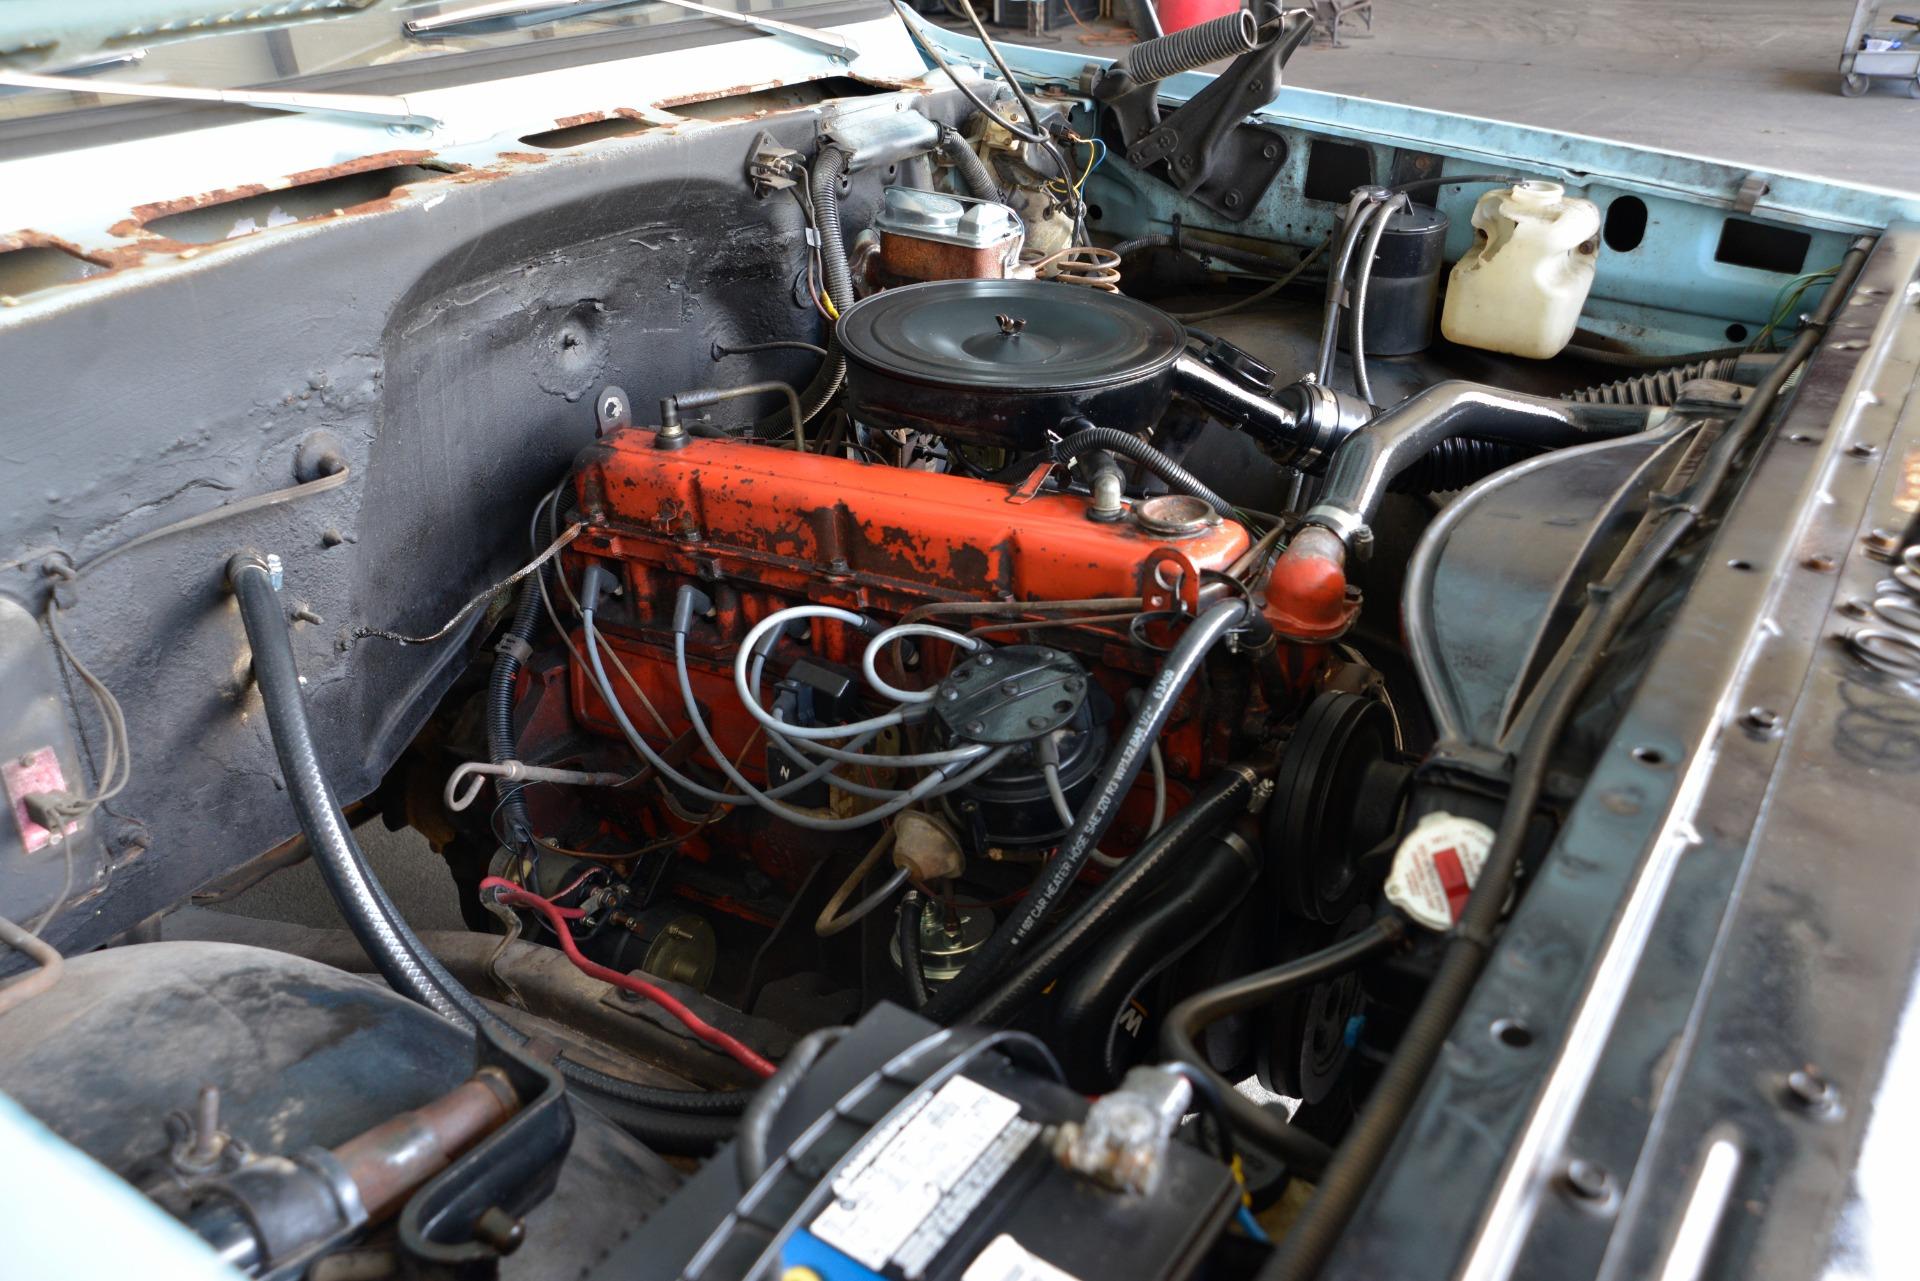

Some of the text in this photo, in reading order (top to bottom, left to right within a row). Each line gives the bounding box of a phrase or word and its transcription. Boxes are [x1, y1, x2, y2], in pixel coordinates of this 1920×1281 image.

[1031, 898, 1049, 918] CAR
[1043, 861, 1073, 899] HEATER
[1068, 834, 1090, 862] HOSE
[1084, 813, 1102, 835] SAE
[1097, 795, 1111, 815] J20
[1105, 780, 1119, 796] R3
[1129, 727, 1145, 747] BAR
